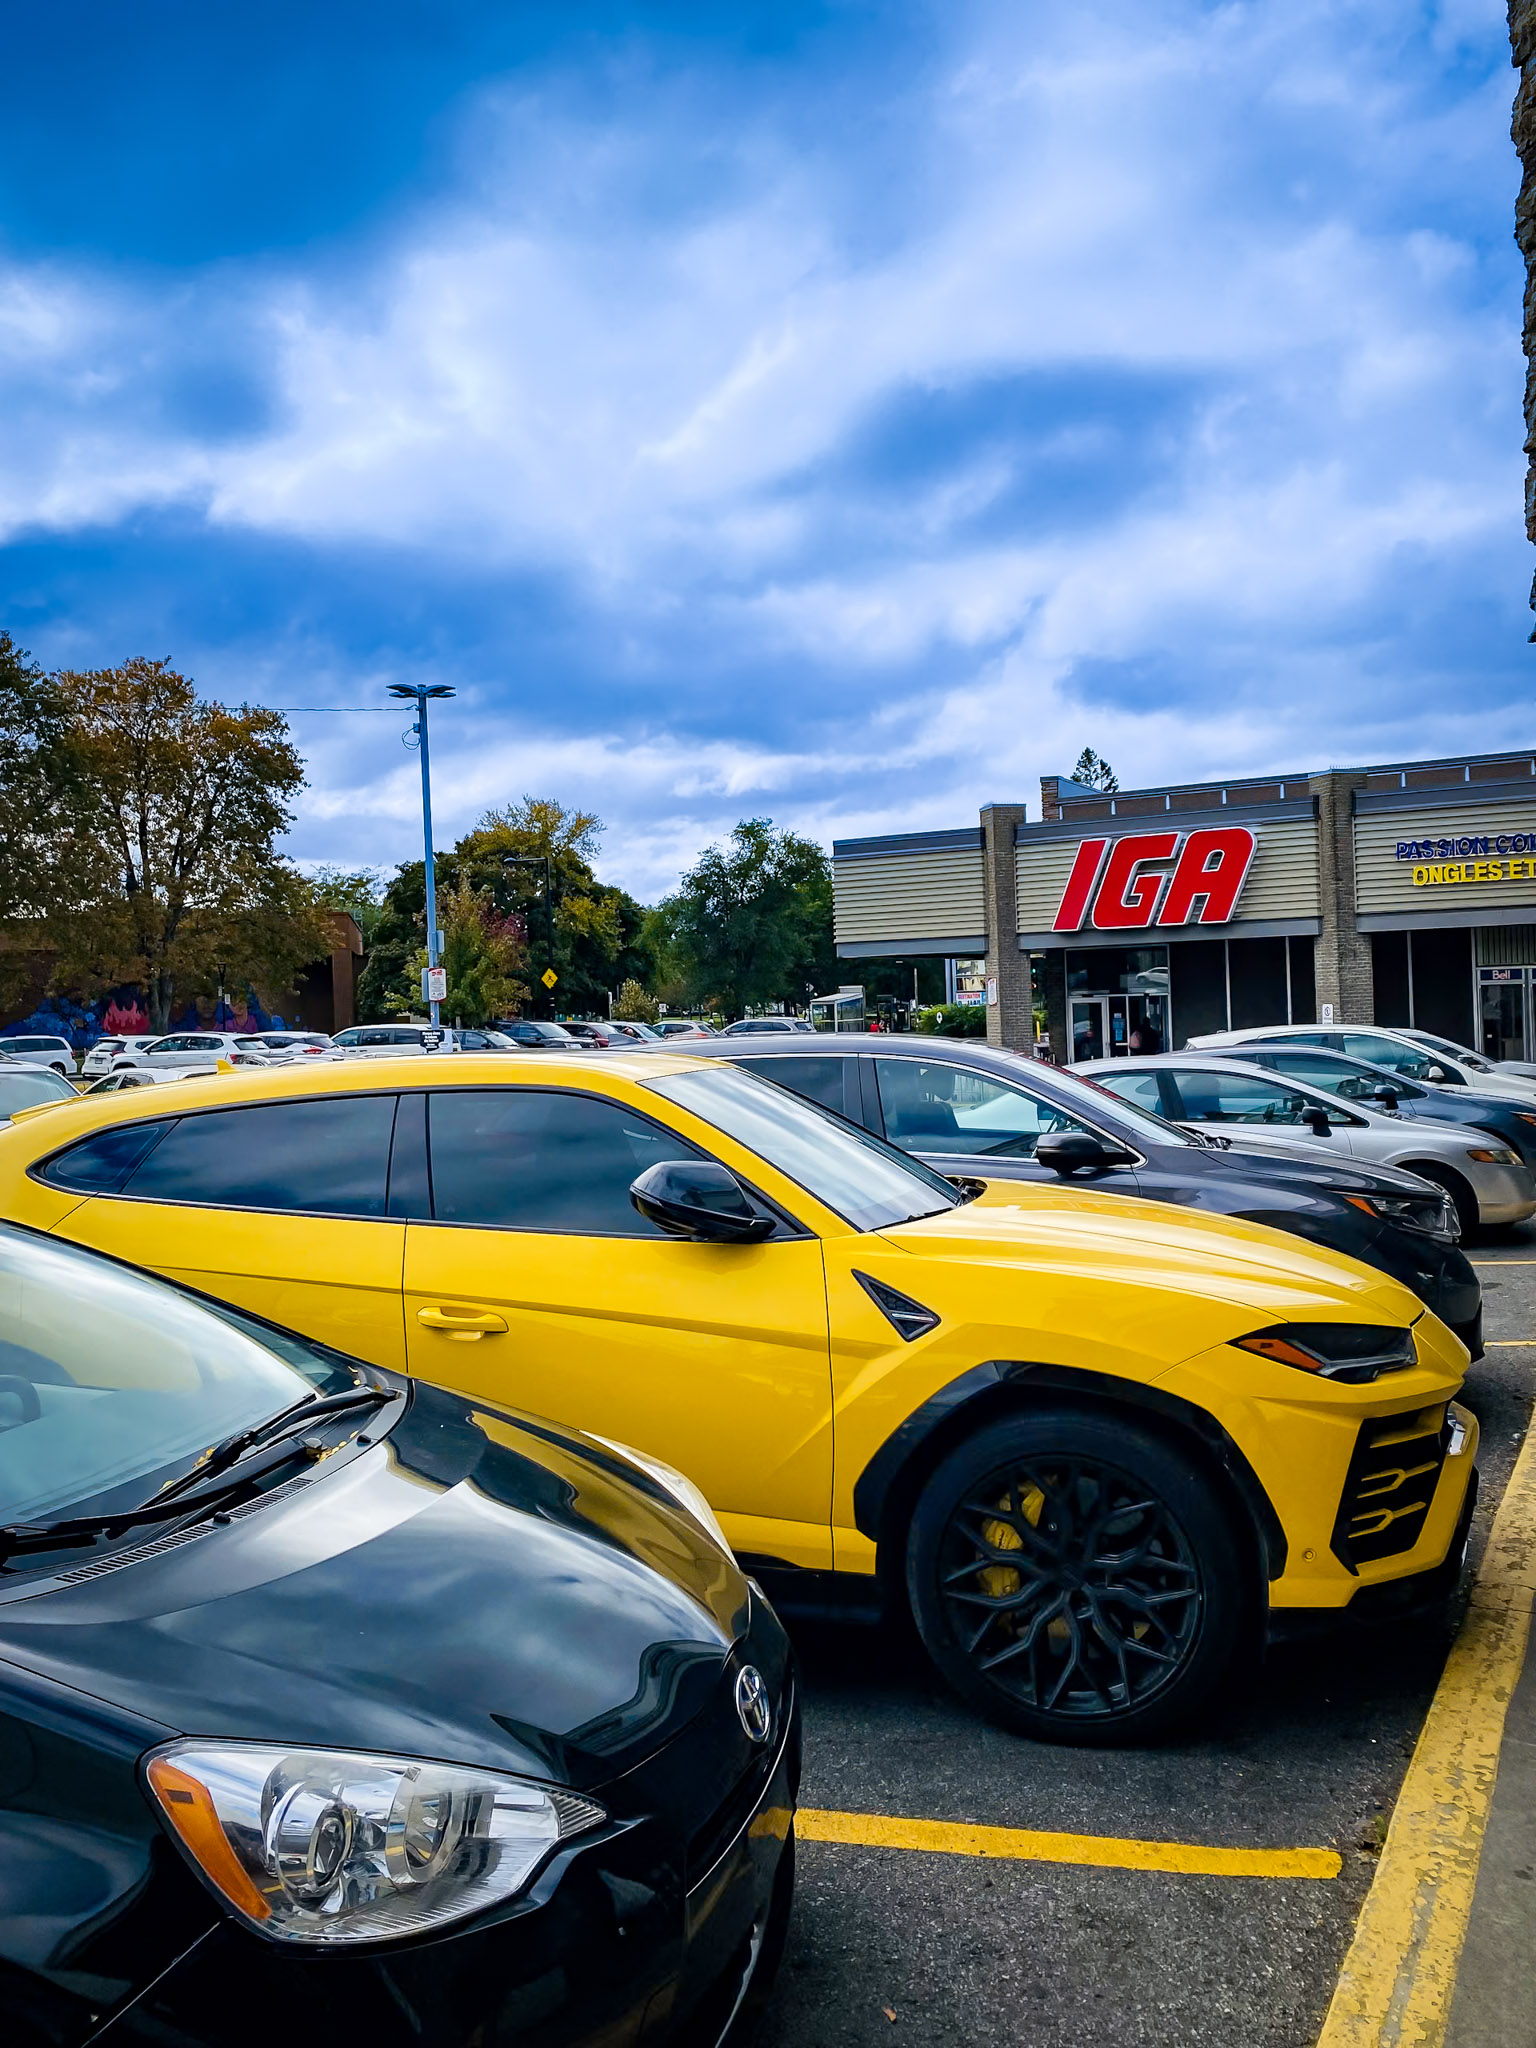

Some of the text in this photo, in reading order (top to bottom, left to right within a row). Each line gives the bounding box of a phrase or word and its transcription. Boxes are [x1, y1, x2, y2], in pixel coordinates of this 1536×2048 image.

[1395, 836, 1489, 860] PASSION
[1051, 826, 1257, 932] IGA
[1413, 857, 1536, 886] ONGLES ET
[1492, 969, 1510, 980] Bell
